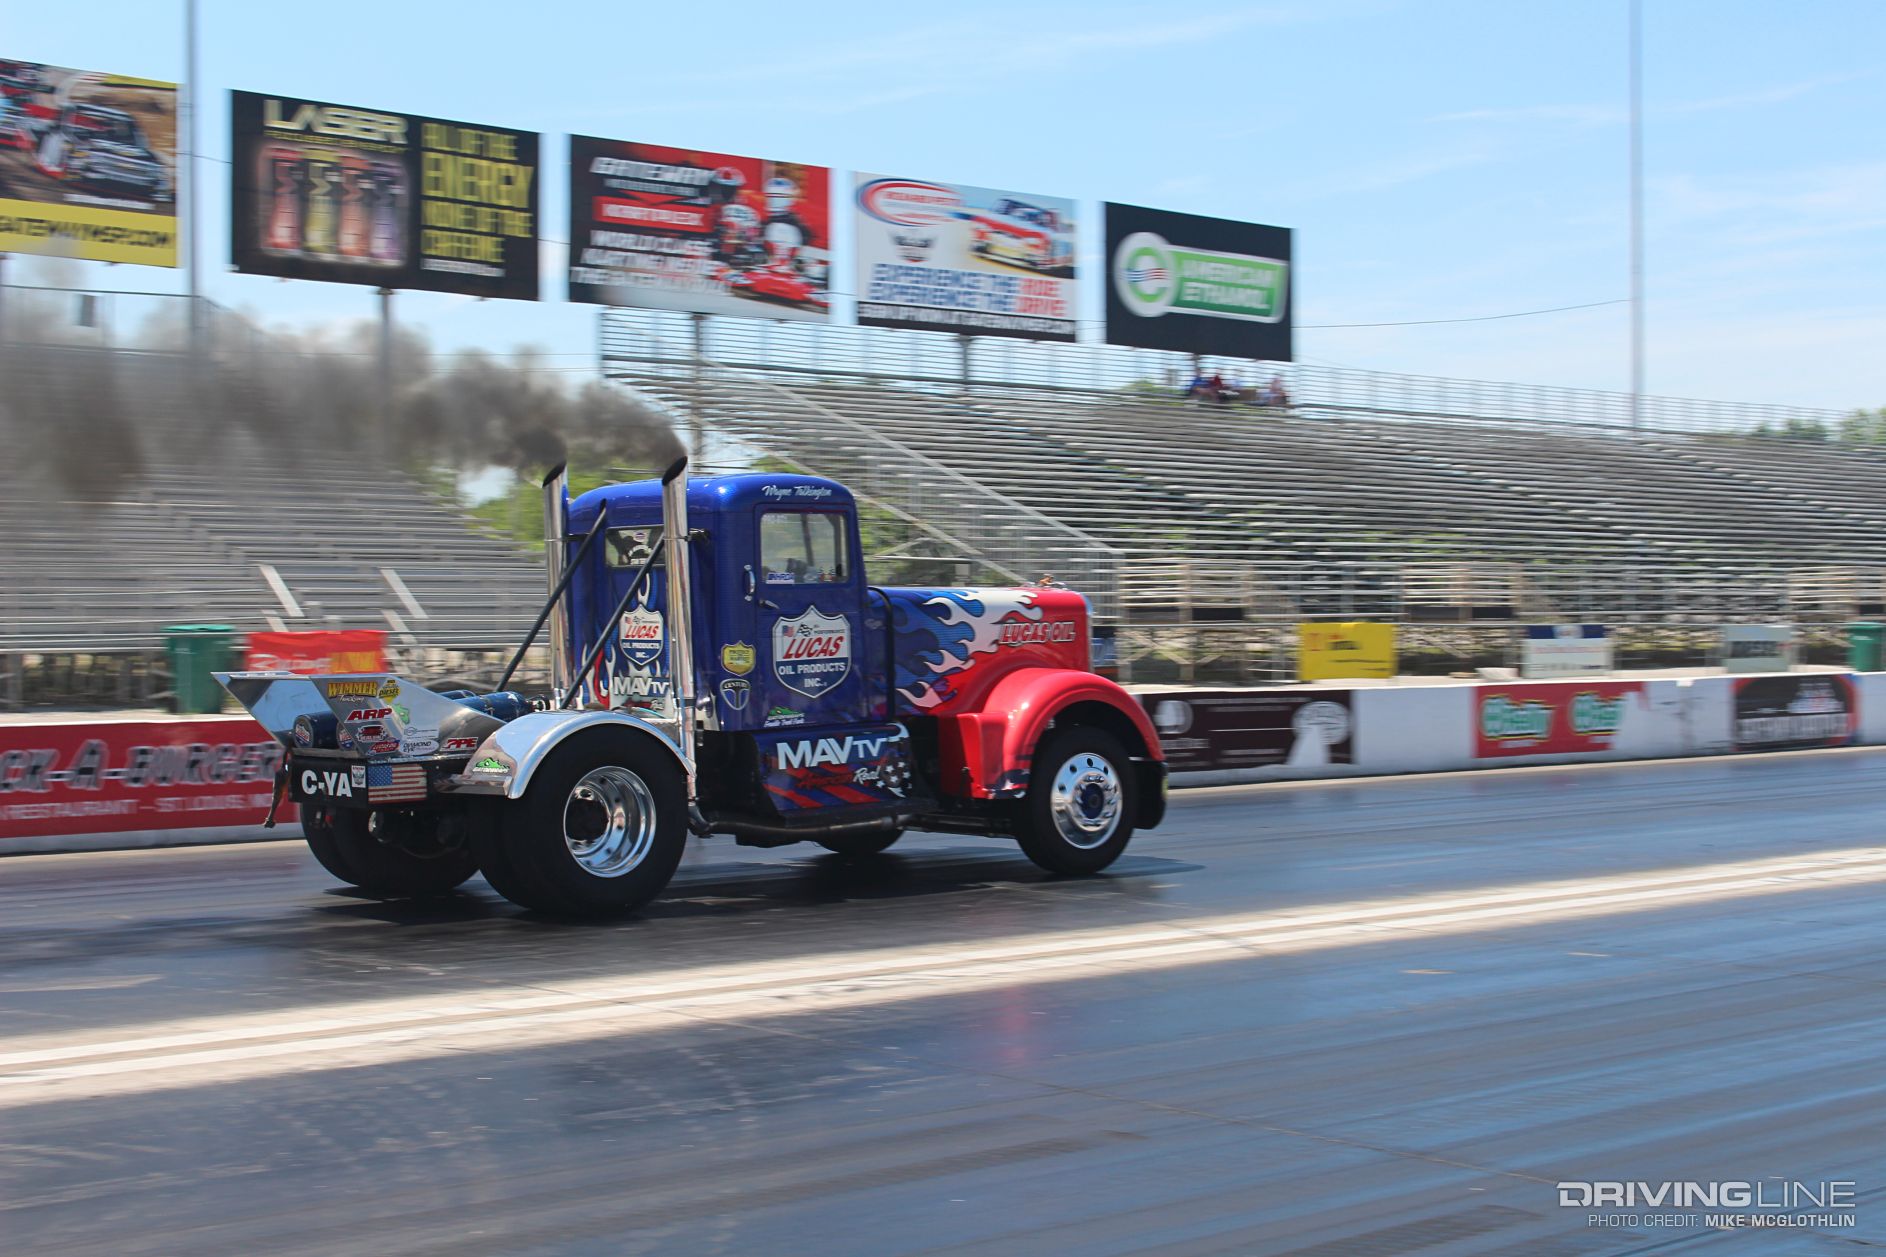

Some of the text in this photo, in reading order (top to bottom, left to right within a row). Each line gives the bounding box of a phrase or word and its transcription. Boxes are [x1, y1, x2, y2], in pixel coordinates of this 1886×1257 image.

[264, 100, 408, 144] LASER
[422, 151, 534, 208] ENERGY
[1183, 259, 1274, 287] AMERICAN
[1183, 281, 1270, 309] ETHANOL
[761, 485, 792, 501] Wayne
[624, 625, 659, 639] LUCAS
[999, 621, 1076, 644] LUCAS OIL
[783, 636, 845, 659] LUCAS
[778, 663, 846, 675] OIL PRODUCTS
[328, 681, 378, 698] WIMMER
[379, 687, 400, 697] DIESEL
[347, 708, 393, 721] ARP
[446, 737, 478, 749] PPE
[776, 736, 888, 770] MAVTV
[301, 769, 352, 798] C-YA
